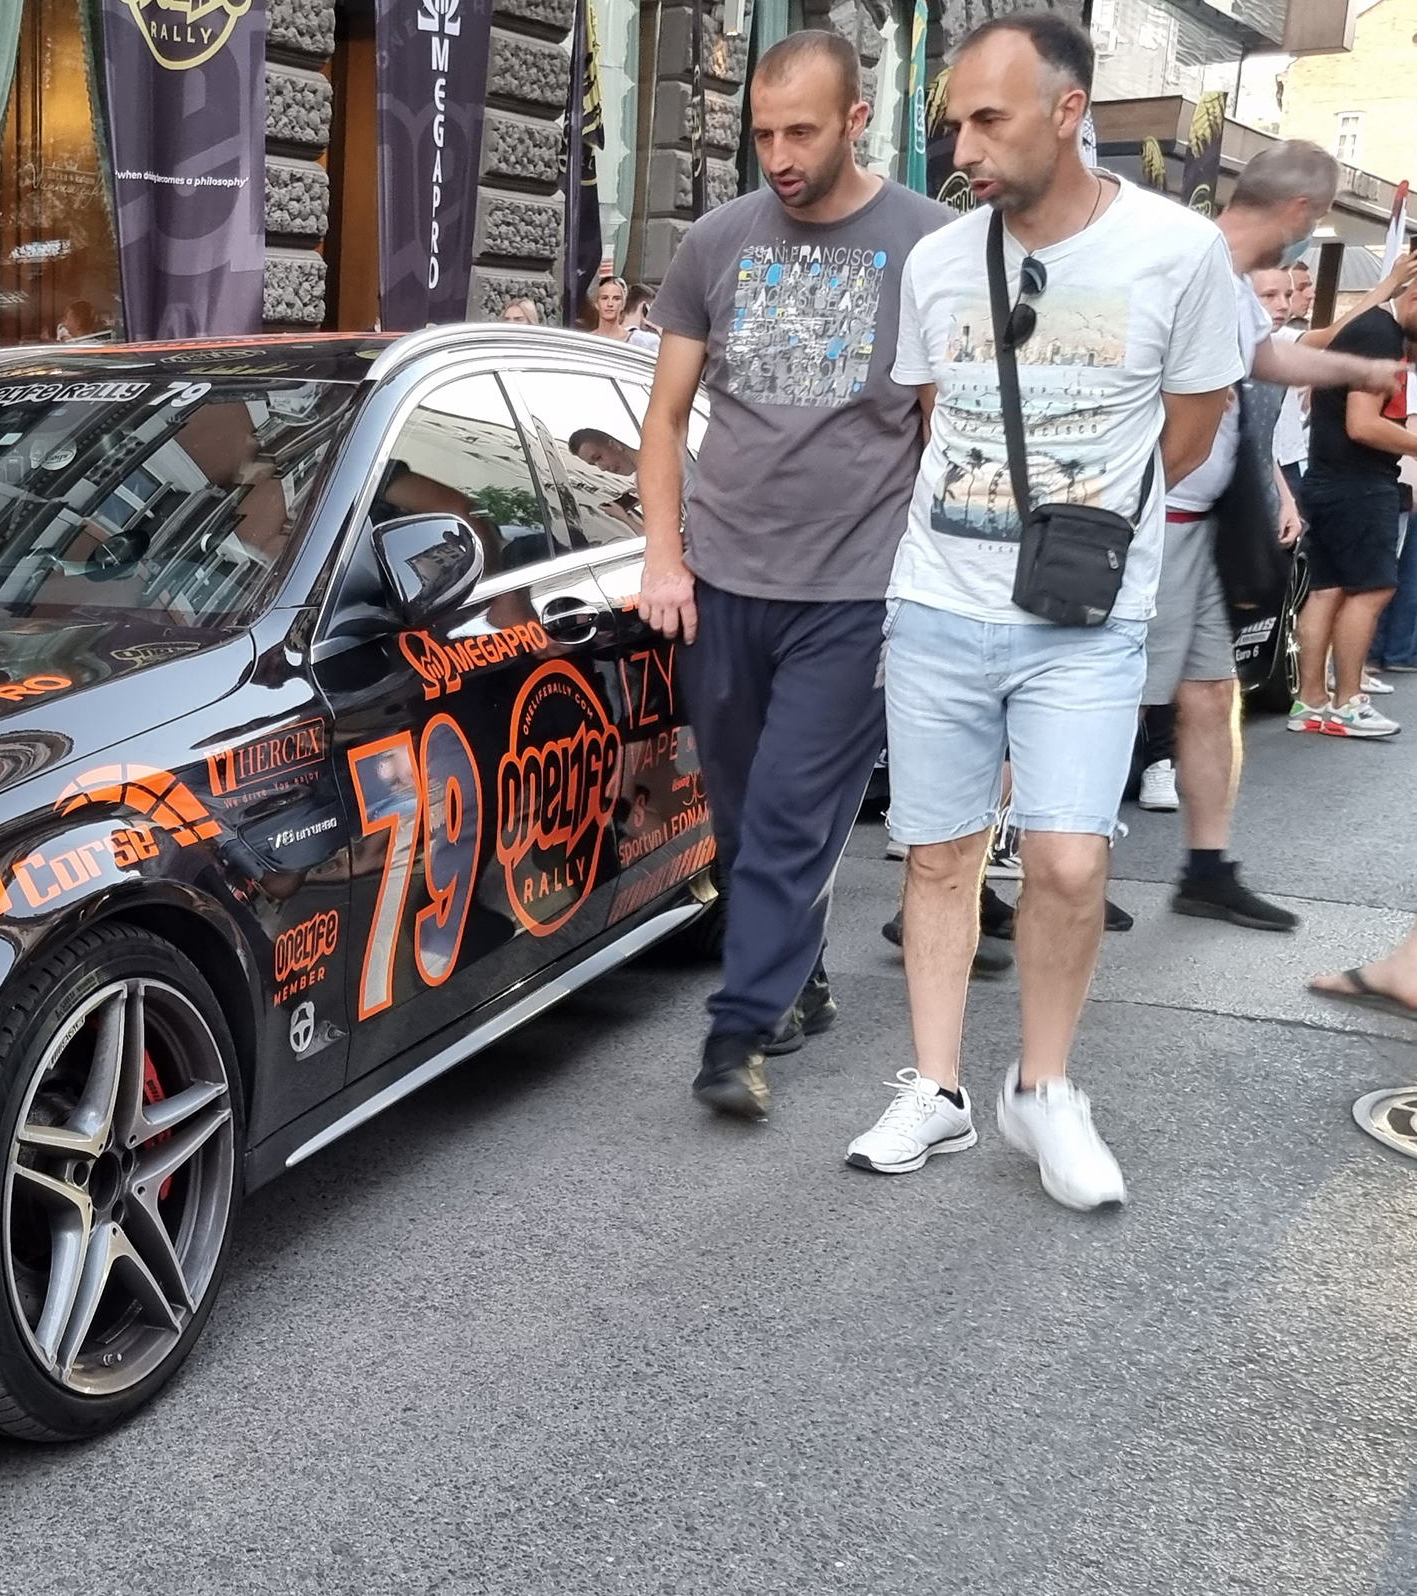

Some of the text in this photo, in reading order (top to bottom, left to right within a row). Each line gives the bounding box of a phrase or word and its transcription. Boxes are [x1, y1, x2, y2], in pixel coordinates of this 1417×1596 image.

[149, 20, 212, 45] RALLY
[185, 177, 193, 185] a
[148, 381, 213, 408] 79
[444, 620, 549, 673] MEGAPRO
[619, 643, 675, 730] IZY
[237, 726, 321, 780] HERCEX
[631, 726, 680, 775] VAPE
[223, 797, 238, 809] We
[243, 788, 268, 803] drive
[11, 823, 161, 909] Corse
[346, 712, 484, 1023] 79
[523, 855, 586, 905] RALLY
[273, 966, 326, 1008] MEMBER
